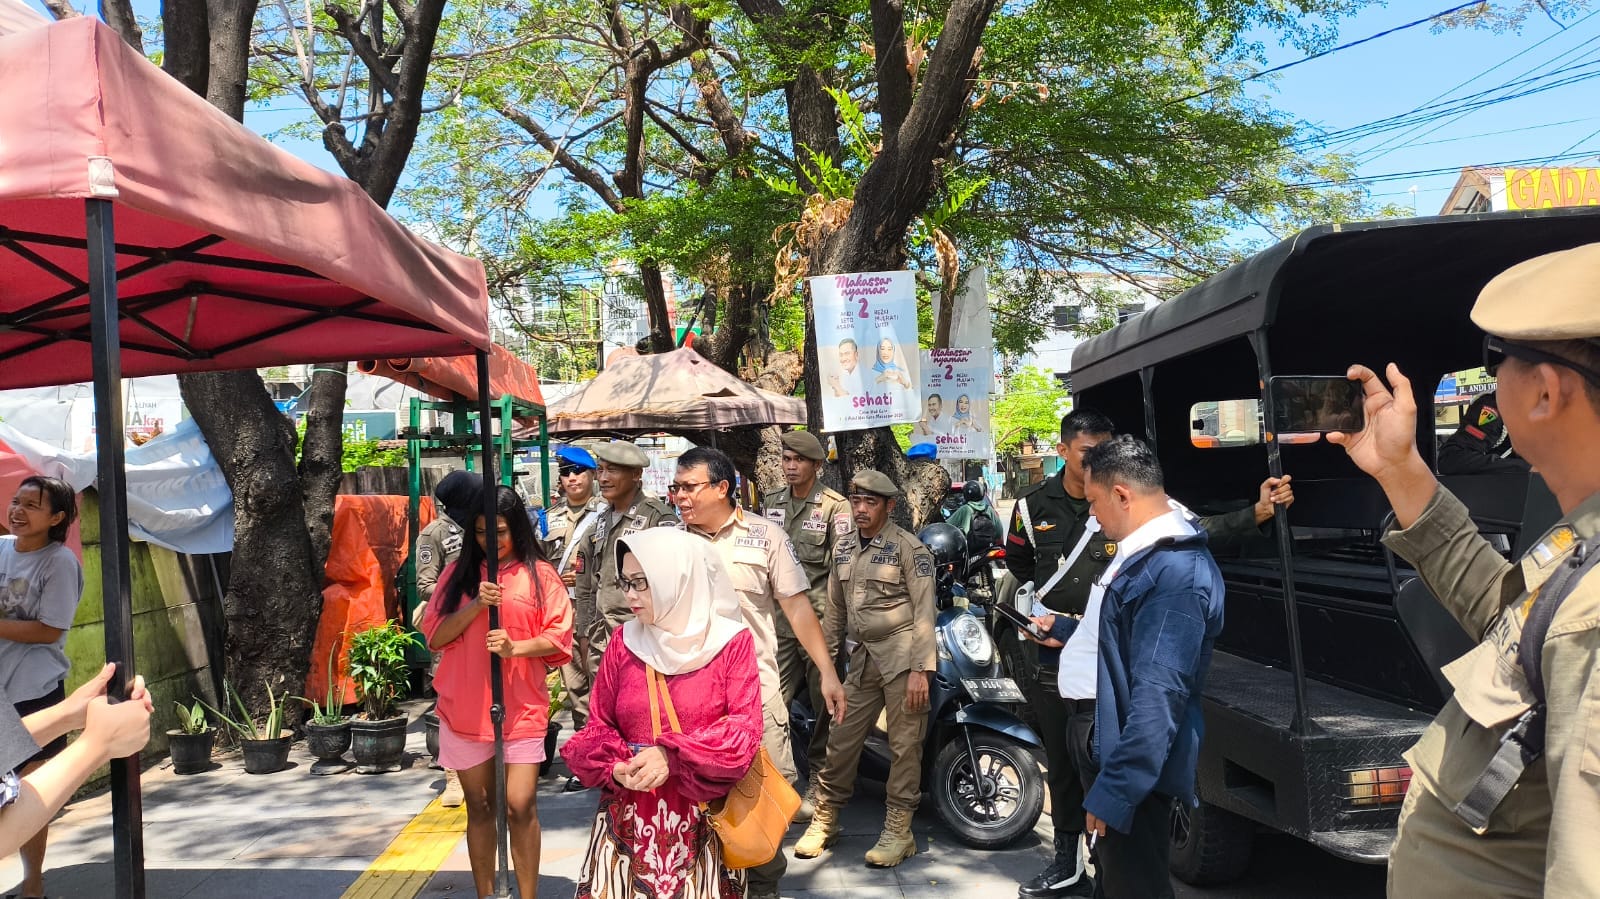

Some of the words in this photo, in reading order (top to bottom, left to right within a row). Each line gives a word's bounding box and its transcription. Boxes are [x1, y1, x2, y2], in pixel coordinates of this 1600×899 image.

[835, 274, 892, 288] Makassar
[841, 287, 888, 301] nyaman
[858, 298, 869, 318] 2
[930, 348, 972, 357] Makassar
[933, 356, 968, 367] nyaman
[944, 364, 953, 380] 2
[1469, 384, 1487, 392] ANDI
[852, 391, 892, 408] sehati
[935, 432, 967, 444] sehati
